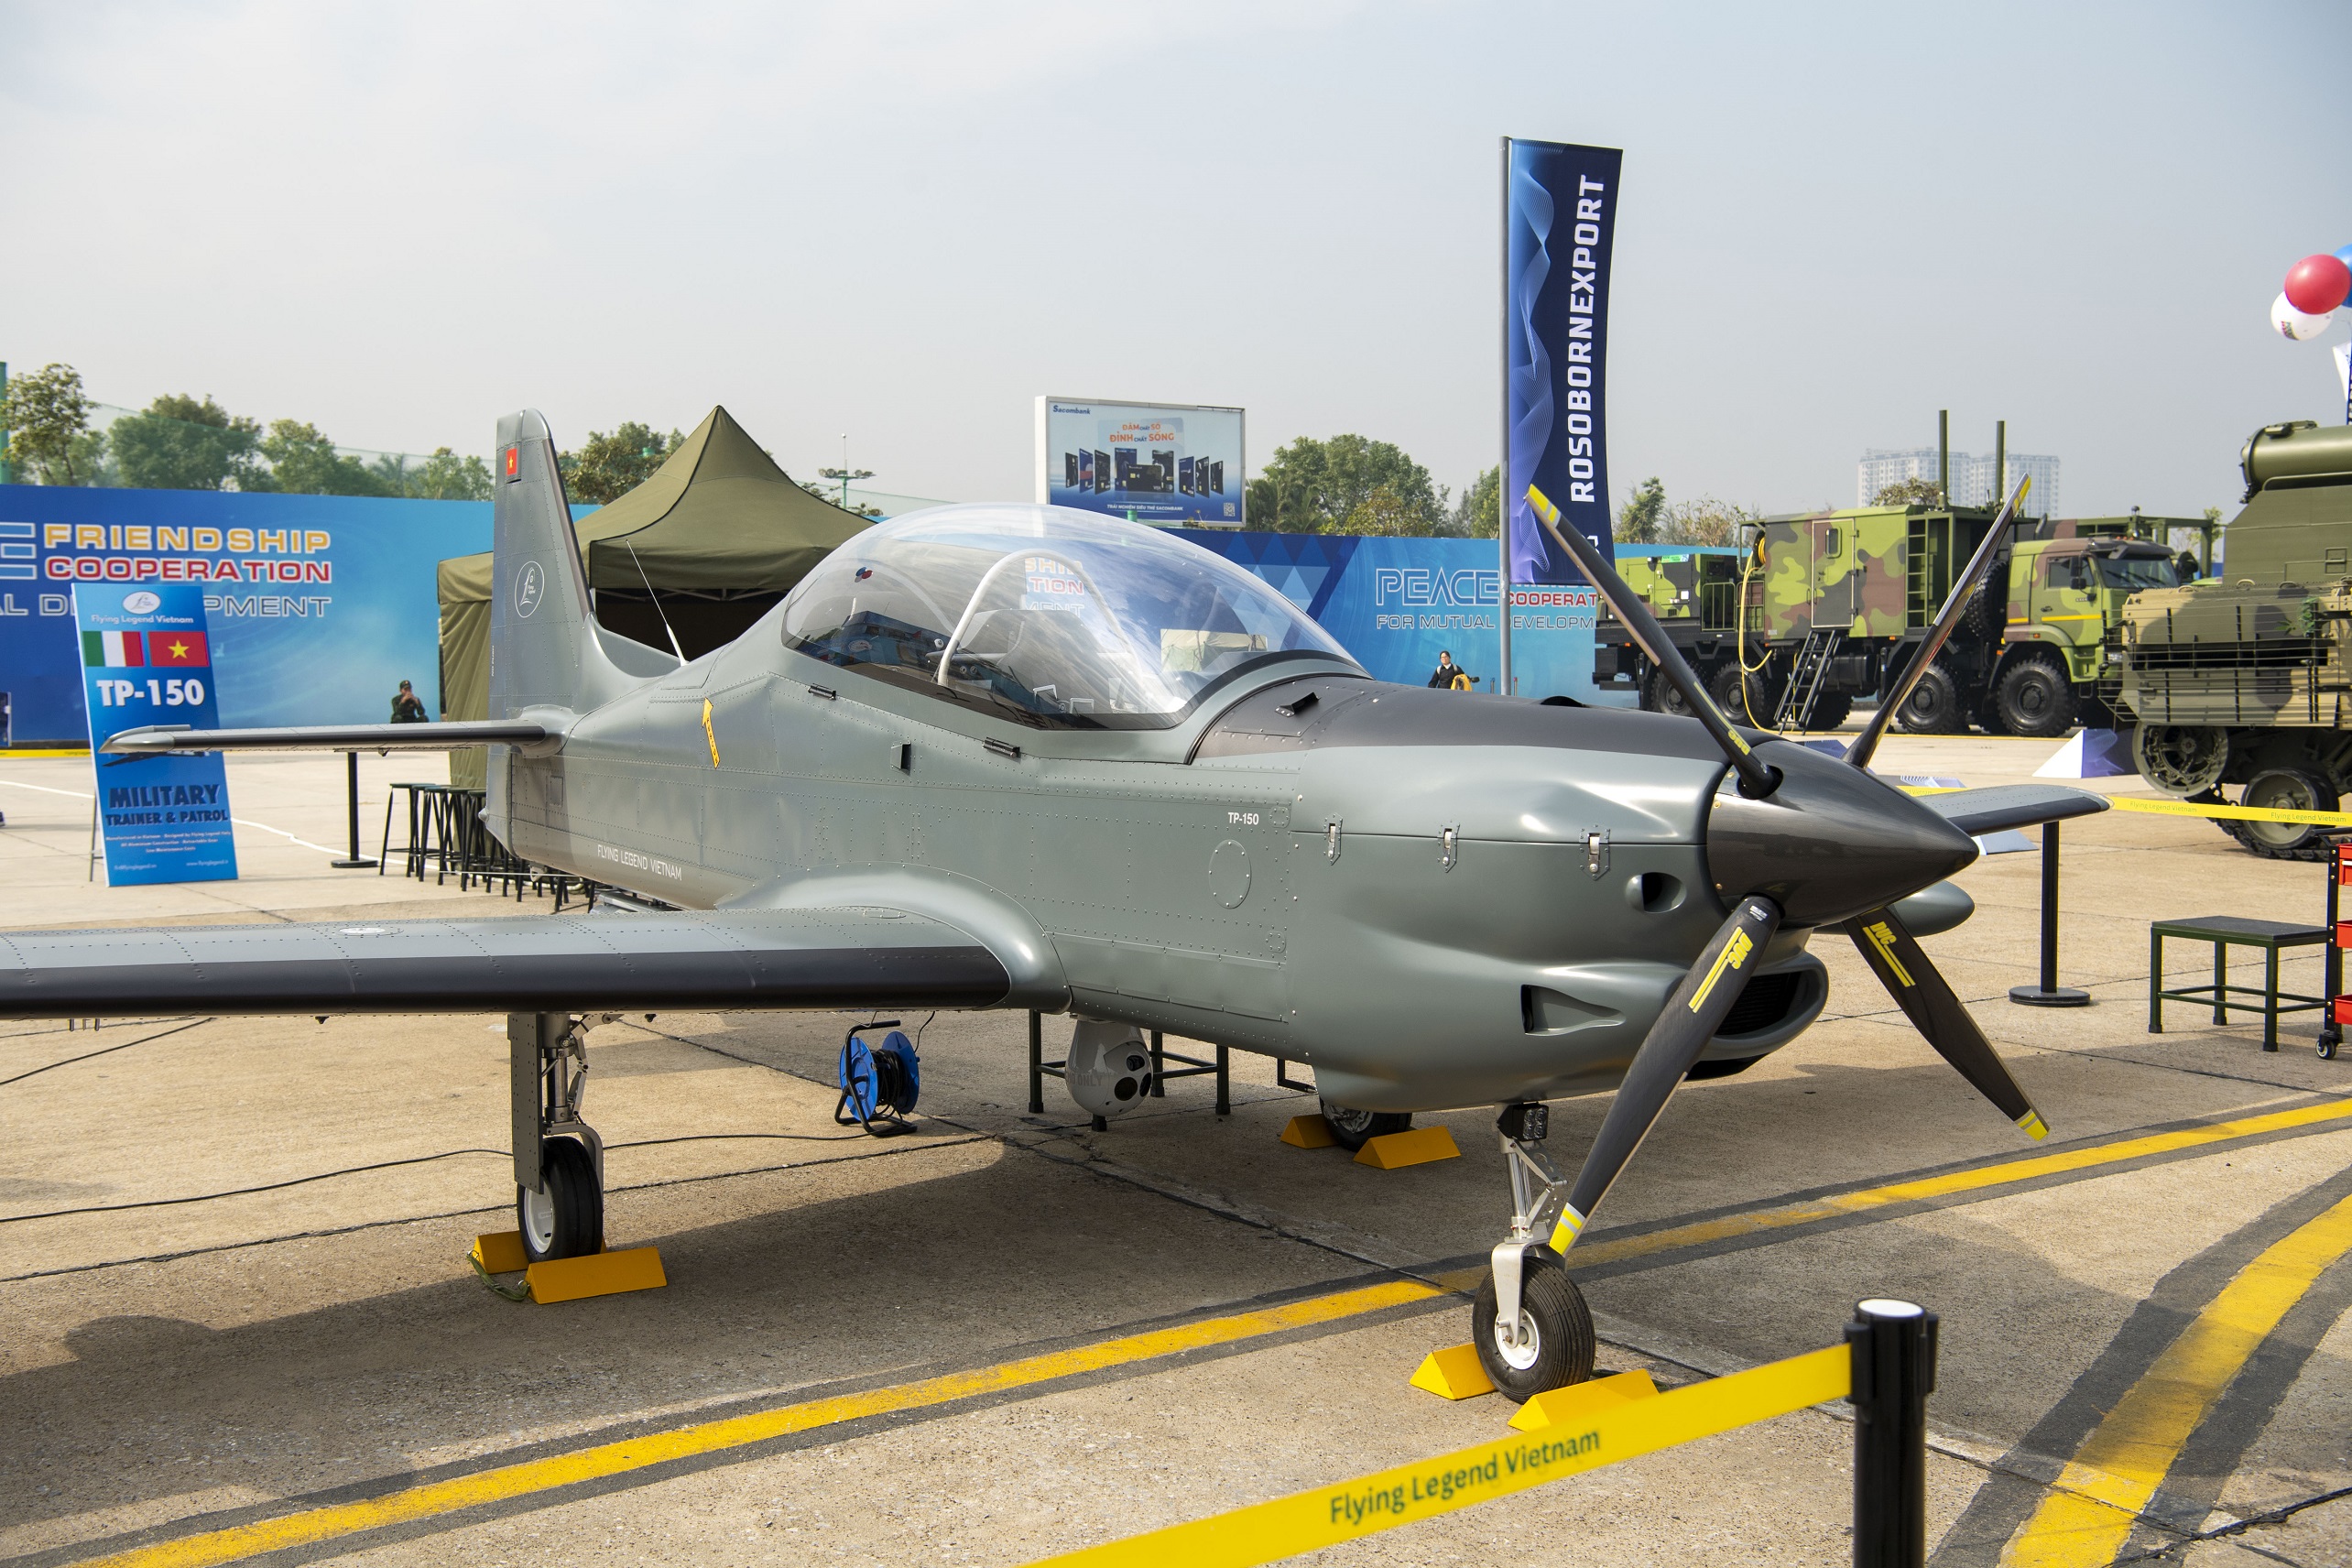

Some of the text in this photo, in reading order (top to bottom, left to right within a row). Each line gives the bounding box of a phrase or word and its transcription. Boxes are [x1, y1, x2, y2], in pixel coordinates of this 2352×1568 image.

[1568, 174, 1605, 503] ROSOBORNEXPORT
[1052, 405, 1091, 415] Sacombank
[1149, 430, 1174, 441] SỐNG
[44, 523, 331, 554] FRIENDSHIP
[45, 556, 332, 583] COOPERATION
[1376, 566, 1499, 606] PEACE
[92, 615, 194, 625] Flying Legend Vietnam
[1377, 615, 1415, 630] FOR
[1419, 615, 1496, 630] MUTUAL
[95, 679, 205, 707] TP-150
[109, 784, 221, 809] MILITARY
[2129, 800, 2197, 812] Flying Legend Vietnam
[105, 810, 228, 826] TRAINER & PATROL
[1227, 811, 1259, 825] TP-150
[2270, 811, 2347, 822] Flying Legend Vietnam
[597, 844, 682, 881] FLYING LEGEND VIETNAM
[1869, 920, 1897, 945] DUC
[1727, 931, 1754, 970] DUC
[1329, 1428, 1602, 1526] Flying Legend Vietnam
